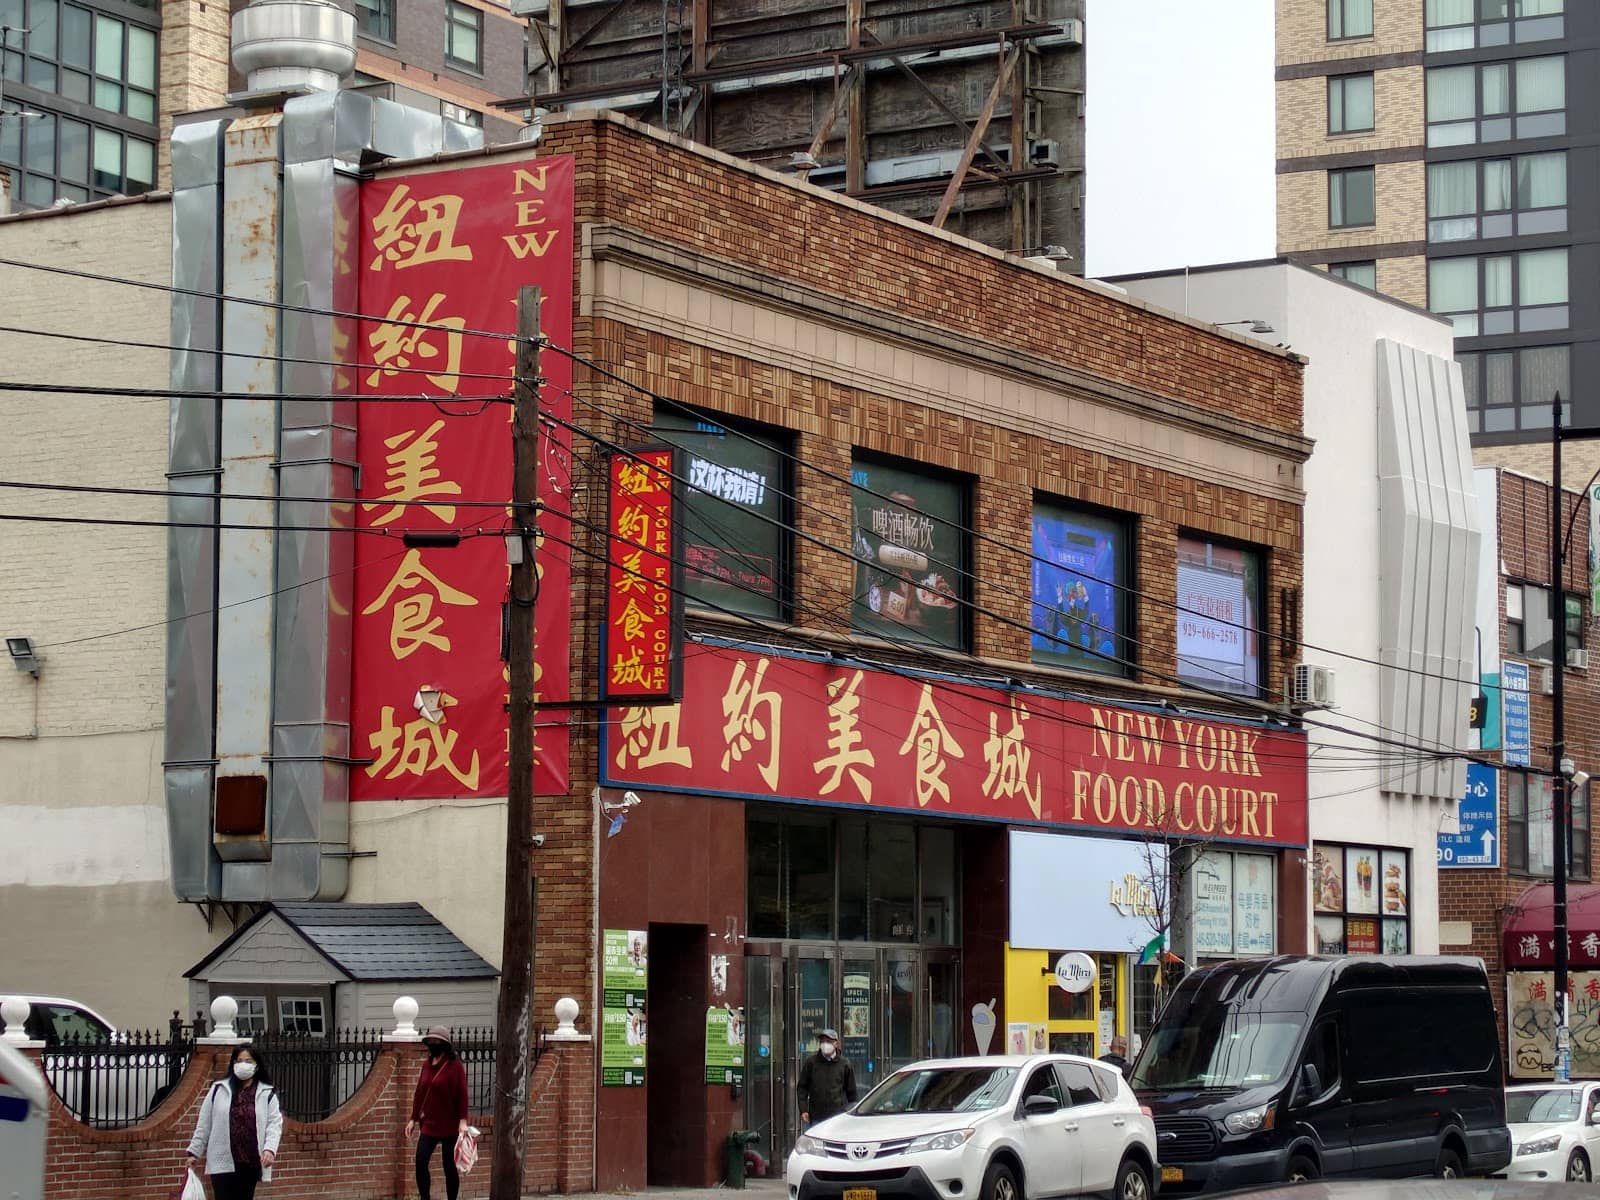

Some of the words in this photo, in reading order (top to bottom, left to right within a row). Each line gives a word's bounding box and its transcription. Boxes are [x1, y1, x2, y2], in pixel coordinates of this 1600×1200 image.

[502, 166, 560, 259] NEW
[362, 184, 480, 791] 紐約美食城
[655, 456, 671, 492] NEW
[655, 505, 669, 554] YORK
[872, 508, 934, 550] 啤酒畅饮
[612, 462, 655, 690] 紐約美食城
[654, 567, 669, 616] FOOD
[653, 629, 667, 690] COURT
[615, 659, 1042, 820] 紐約美食城
[1090, 708, 1168, 765] NEW
[1172, 719, 1263, 777] YORK
[1071, 770, 1166, 827] FOOD
[1174, 781, 1279, 838] COURT
[1069, 964, 1091, 980] Mira
[1519, 932, 1600, 960] 满香
